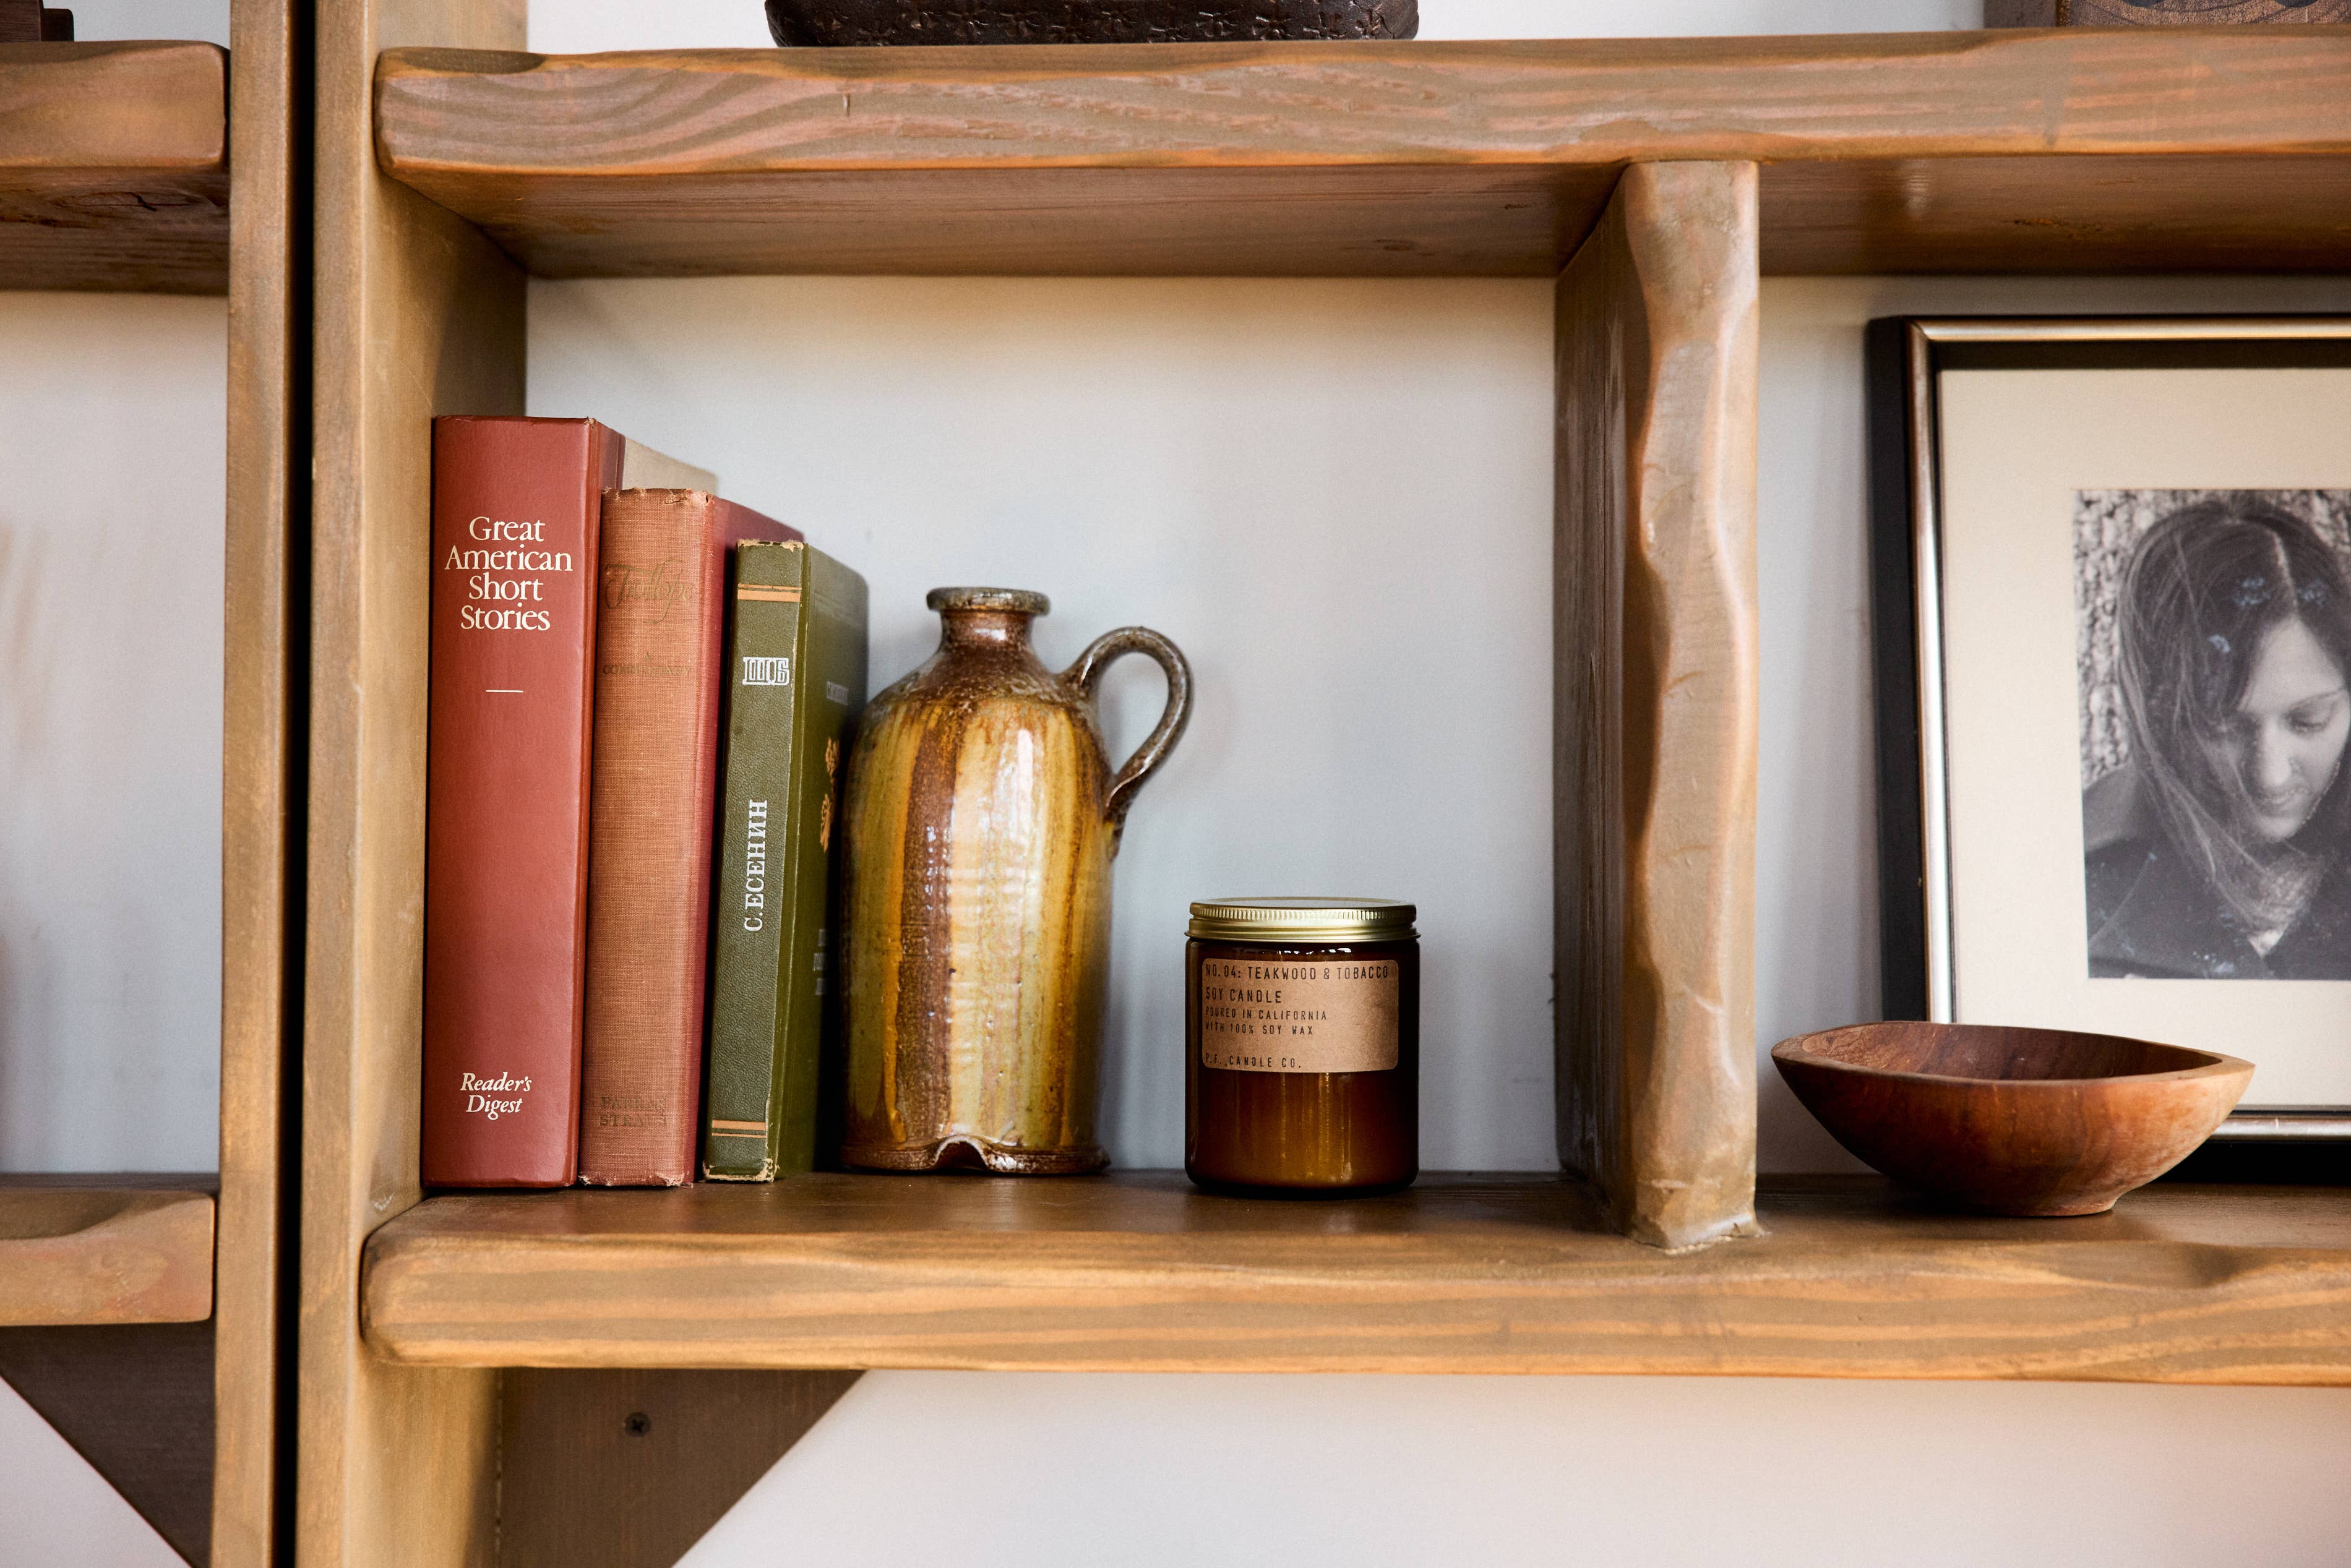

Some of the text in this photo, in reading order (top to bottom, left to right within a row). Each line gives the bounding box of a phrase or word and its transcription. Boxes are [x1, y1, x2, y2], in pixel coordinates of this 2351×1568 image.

[469, 516, 546, 542] Great
[444, 544, 574, 572] American
[469, 572, 544, 601] Short
[460, 602, 551, 631] Stories
[1247, 966, 1316, 980] TEAKWOOD
[1323, 968, 1330, 980] &
[1336, 965, 1389, 980] TOBACCO
[1206, 987, 1282, 1003] SOY CANDLE
[1205, 1006, 1327, 1020] POURED IN CALIFORNIA
[1205, 1021, 1313, 1035] WITH 100% SOY WAX
[1205, 1053, 1302, 1069] P.F. CANDLE CO.
[460, 1071, 533, 1092] Reader's
[465, 1094, 523, 1121] Digest
